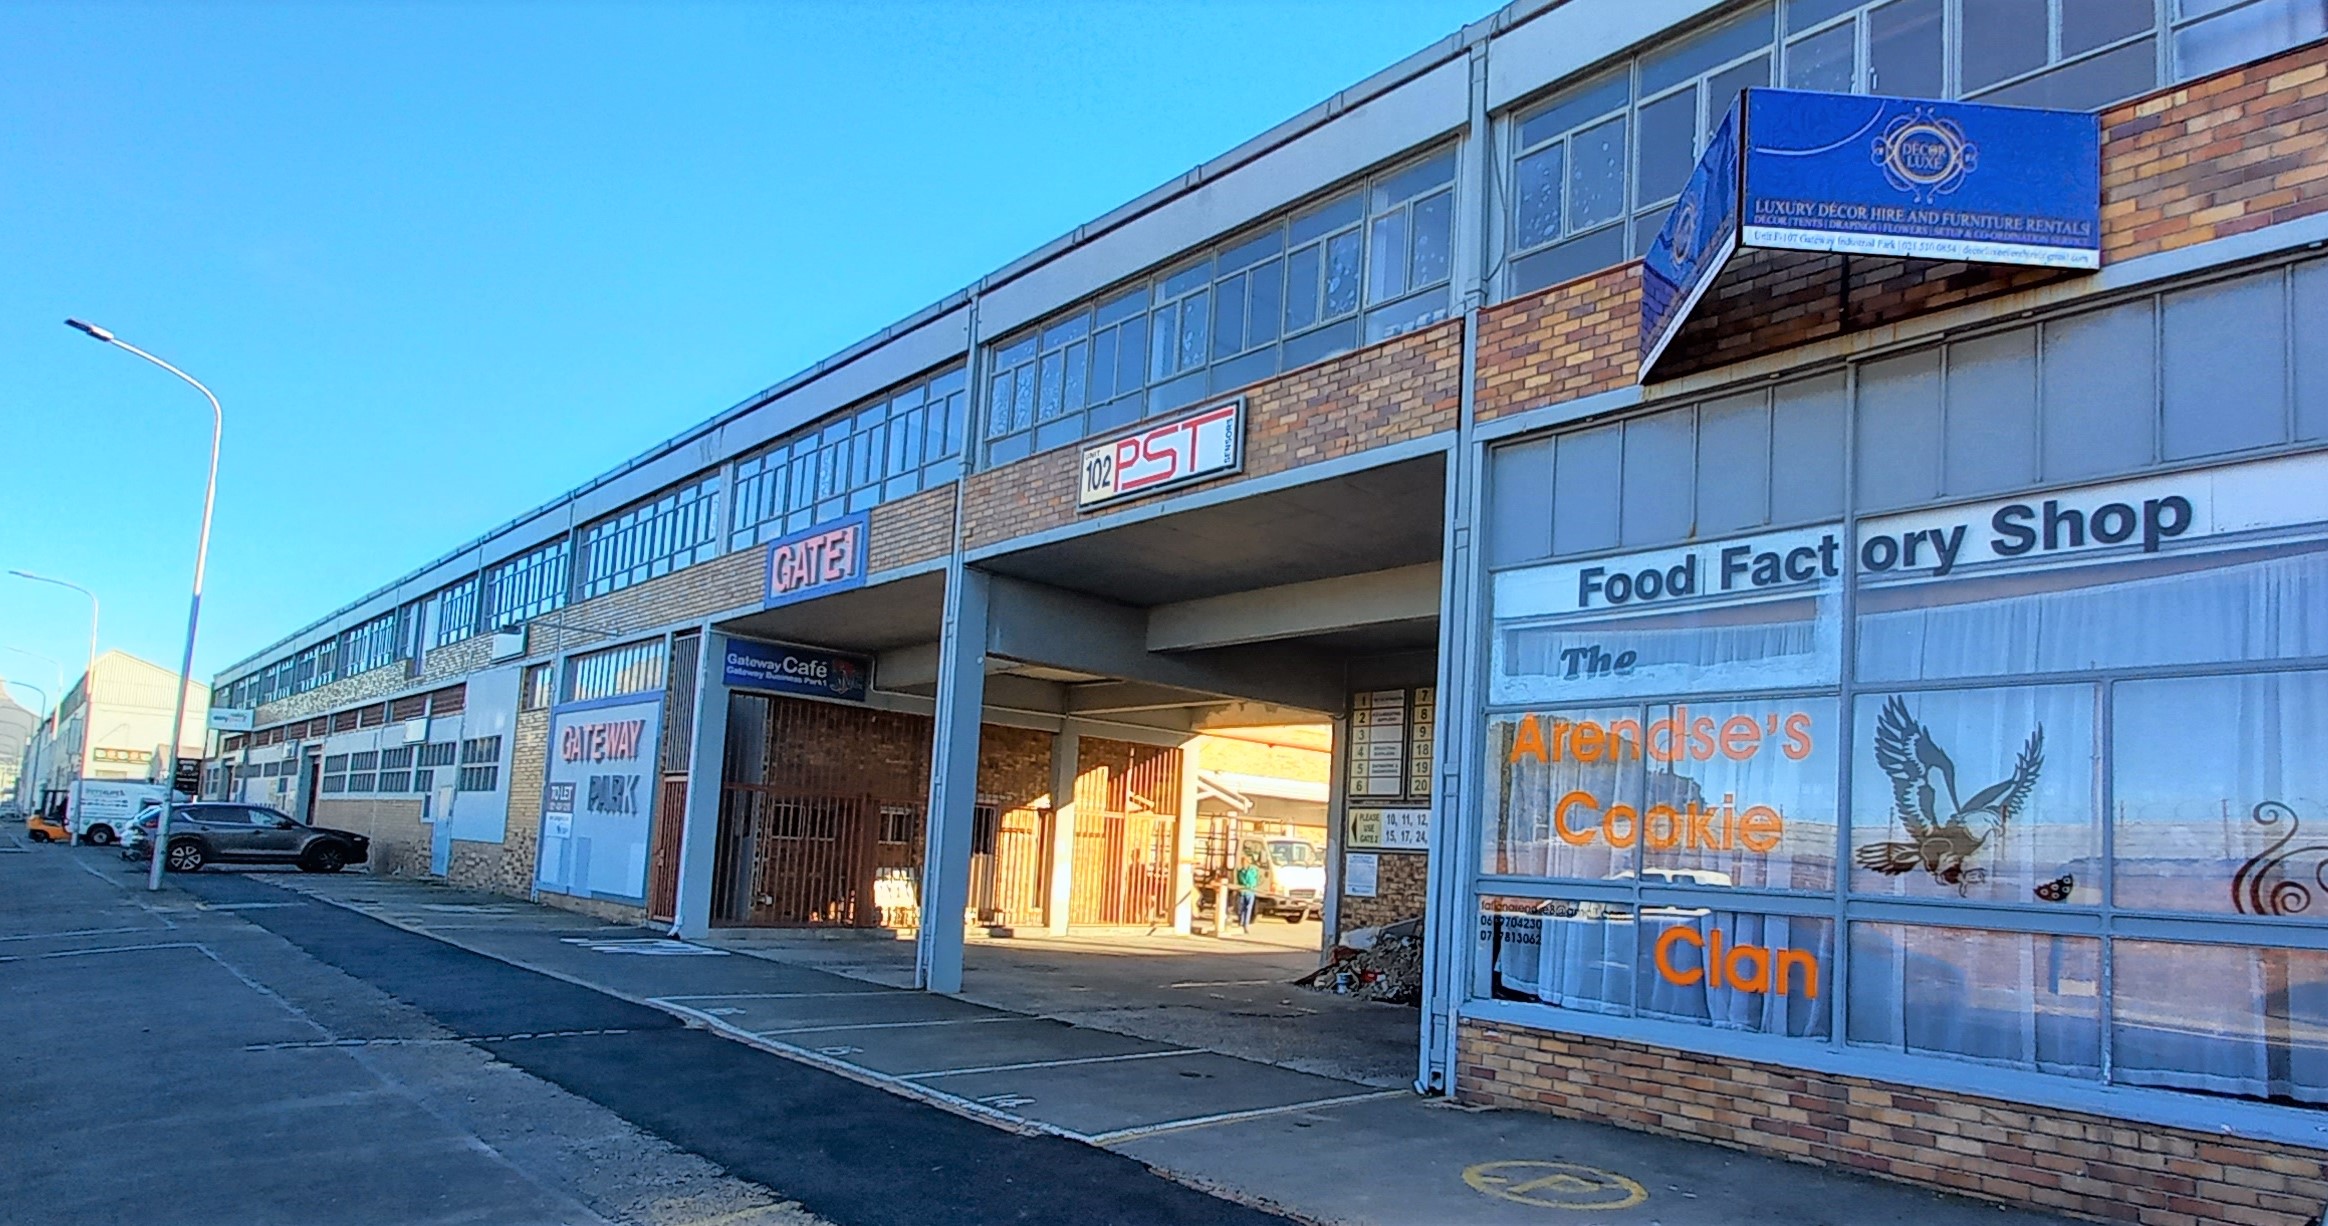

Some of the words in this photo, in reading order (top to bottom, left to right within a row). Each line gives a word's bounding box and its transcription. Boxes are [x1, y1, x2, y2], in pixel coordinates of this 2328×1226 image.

[1907, 157, 1943, 170] LUXE
[1755, 200, 1817, 216] LUXURY
[1870, 207, 1904, 222] HIRE
[1908, 210, 1939, 225] AND
[1942, 212, 2026, 232] FURNITURE
[2026, 218, 2091, 236] RENTALS
[1799, 233, 1835, 247] Gateway
[1838, 236, 1875, 248] Industrial
[1877, 239, 1896, 249] Park
[1086, 454, 1112, 492] 102
[1113, 408, 1234, 492] PST
[1086, 450, 1100, 461] UNIT
[1578, 554, 1696, 608] Food
[1720, 523, 1968, 590] Factory
[1990, 495, 2193, 555] Shop
[773, 529, 847, 593] GATE
[727, 653, 782, 674] Gateway
[782, 656, 828, 679] Café
[1560, 644, 1638, 681] The
[726, 666, 764, 680] Gateway
[765, 671, 803, 684] Business
[1422, 690, 1429, 701] 7
[1359, 712, 1366, 723] 2
[1420, 708, 1427, 720] 8
[1358, 729, 1365, 740] 3
[1419, 726, 1426, 738] 9
[563, 719, 646, 764] GATEWAY
[1357, 746, 1364, 757] 4
[1416, 744, 1429, 756] 18
[1357, 763, 1363, 774] 5
[1415, 761, 1428, 773] 19
[1356, 780, 1363, 791] 6
[1414, 779, 1428, 791] 20
[560, 785, 573, 800] LET
[587, 775, 641, 817] PARK
[1360, 813, 1379, 822] PLEASE
[1554, 790, 1783, 852] Cookie
[1363, 824, 1374, 832] USE
[1360, 835, 1374, 843] GATE
[1480, 930, 1542, 945] 077813062
[1654, 925, 1819, 999] Clan
